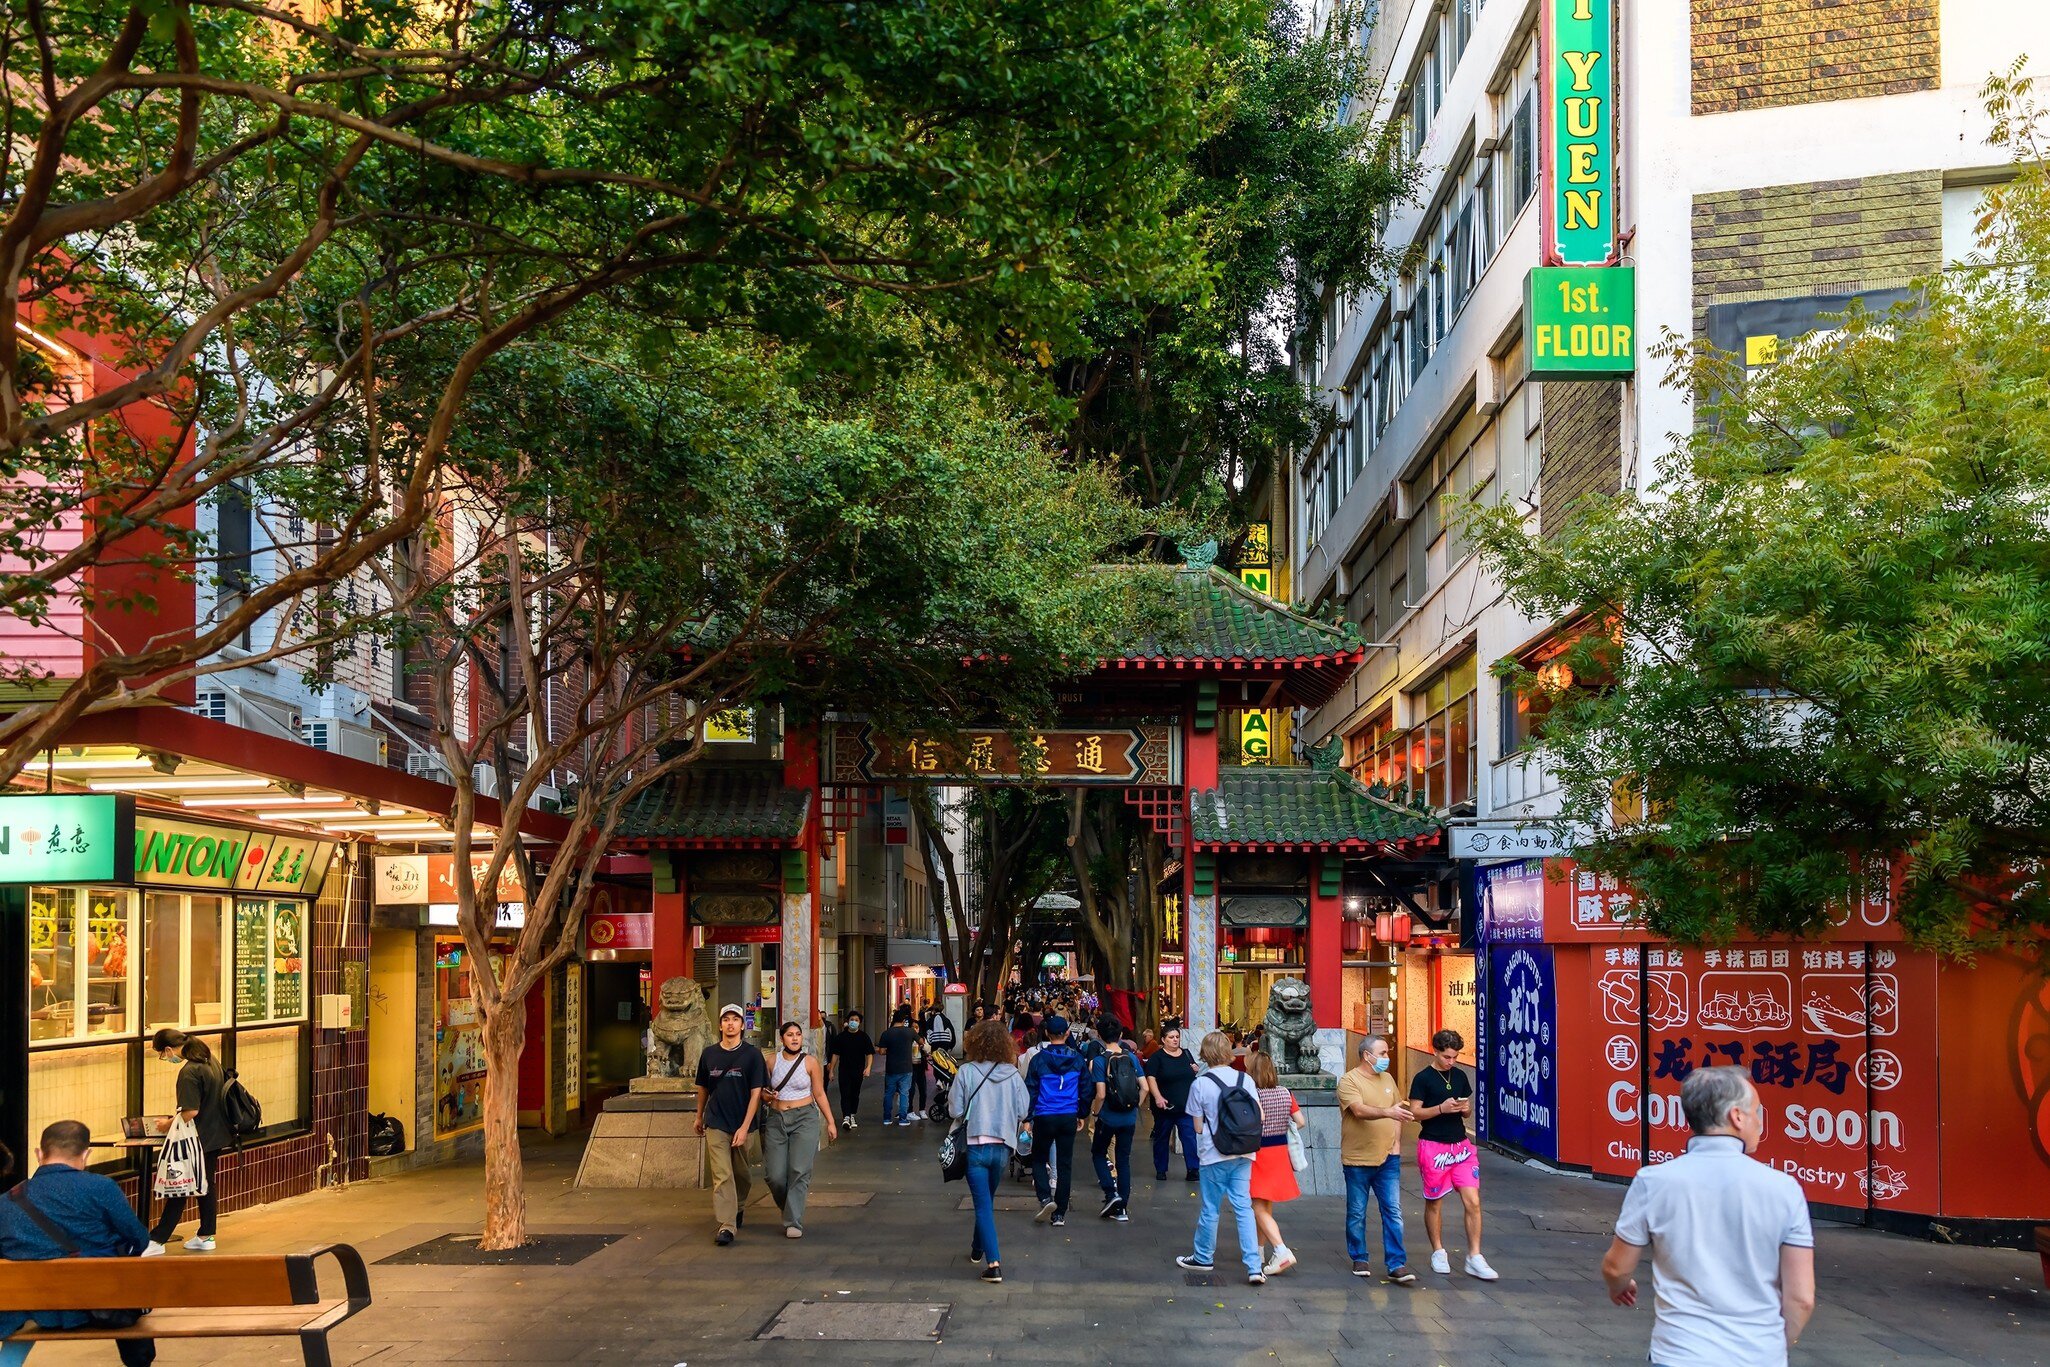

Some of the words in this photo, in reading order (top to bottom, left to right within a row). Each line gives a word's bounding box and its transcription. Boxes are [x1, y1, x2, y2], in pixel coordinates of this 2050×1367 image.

[1562, 51, 1603, 230] YUEN
[1558, 281, 1609, 316] 1st.
[1537, 324, 1630, 357] FLOOR
[1243, 713, 1269, 764] AG
[391, 883, 420, 892] 1980s
[404, 870, 420, 881] In
[1522, 950, 1542, 989] PASTRY
[1604, 948, 1684, 968] 手擀面皮
[1704, 949, 1789, 969] 手揉面团
[1802, 950, 1897, 970] 馅料手炒
[1478, 991, 1486, 1071] Coming
[1610, 1041, 1632, 1064] 真
[1653, 1037, 1852, 1095] 龙门酥局
[1863, 1056, 1894, 1084] 实
[1499, 1086, 1527, 1122] Coming
[1530, 1097, 1550, 1129] soon
[1607, 1081, 1763, 1136] Com
[1784, 1103, 1901, 1148] soon
[1607, 1141, 1675, 1163] Chinese
[1783, 1159, 1846, 1190] Pastry
